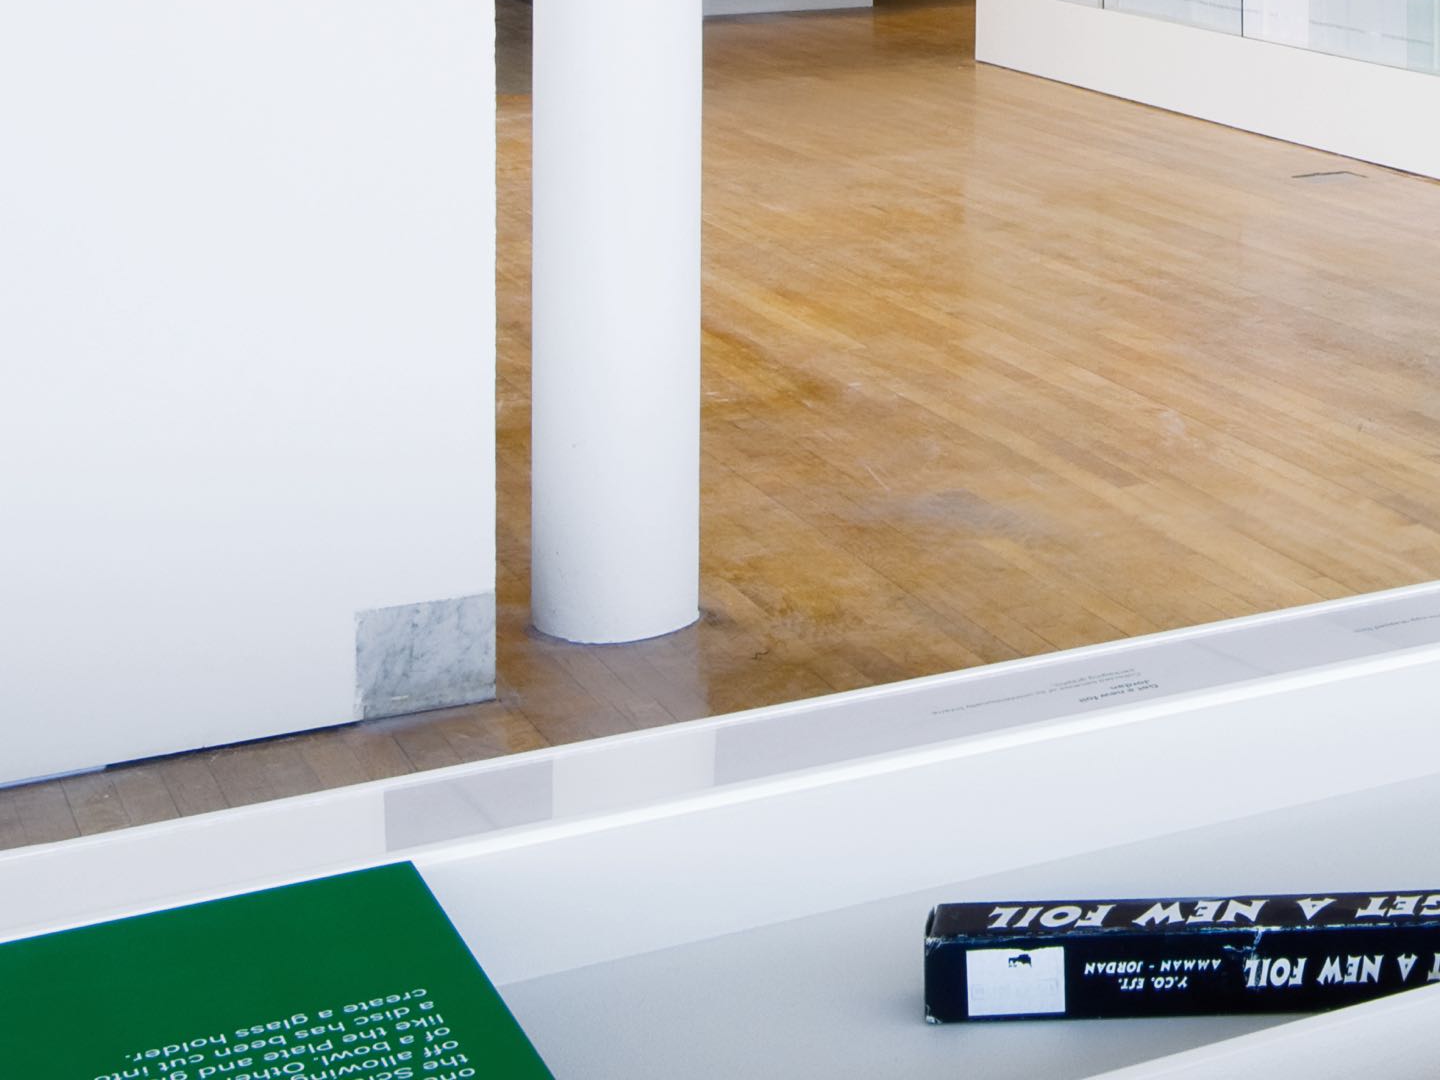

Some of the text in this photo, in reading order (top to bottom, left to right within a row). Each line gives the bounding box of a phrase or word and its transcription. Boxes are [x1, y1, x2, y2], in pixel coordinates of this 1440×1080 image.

[987, 904, 1116, 928] FOIL
[1131, 898, 1270, 927] NEW
[1295, 897, 1338, 921] A
[1084, 961, 1144, 975] JORDAN
[1160, 959, 1221, 973] AMMAN
[1244, 957, 1308, 988] FOIL
[1317, 954, 1384, 986] NEW
[1397, 953, 1418, 982] A
[419, 1001, 434, 1009] a
[354, 1007, 410, 1025] disc
[395, 1013, 444, 1030] like
[125, 989, 427, 1062] create a glass holder.
[294, 1022, 345, 1038] has
[425, 1027, 450, 1042] of
[342, 1027, 386, 1043] the
[400, 1035, 414, 1044] a
[214, 1035, 286, 1057] been
[264, 1039, 334, 1061] Plate
[313, 1041, 391, 1066] bowl.
[423, 1040, 458, 1057] off
[158, 1053, 204, 1071] cut
[198, 1057, 252, 1079] and
[423, 1054, 469, 1070] the
